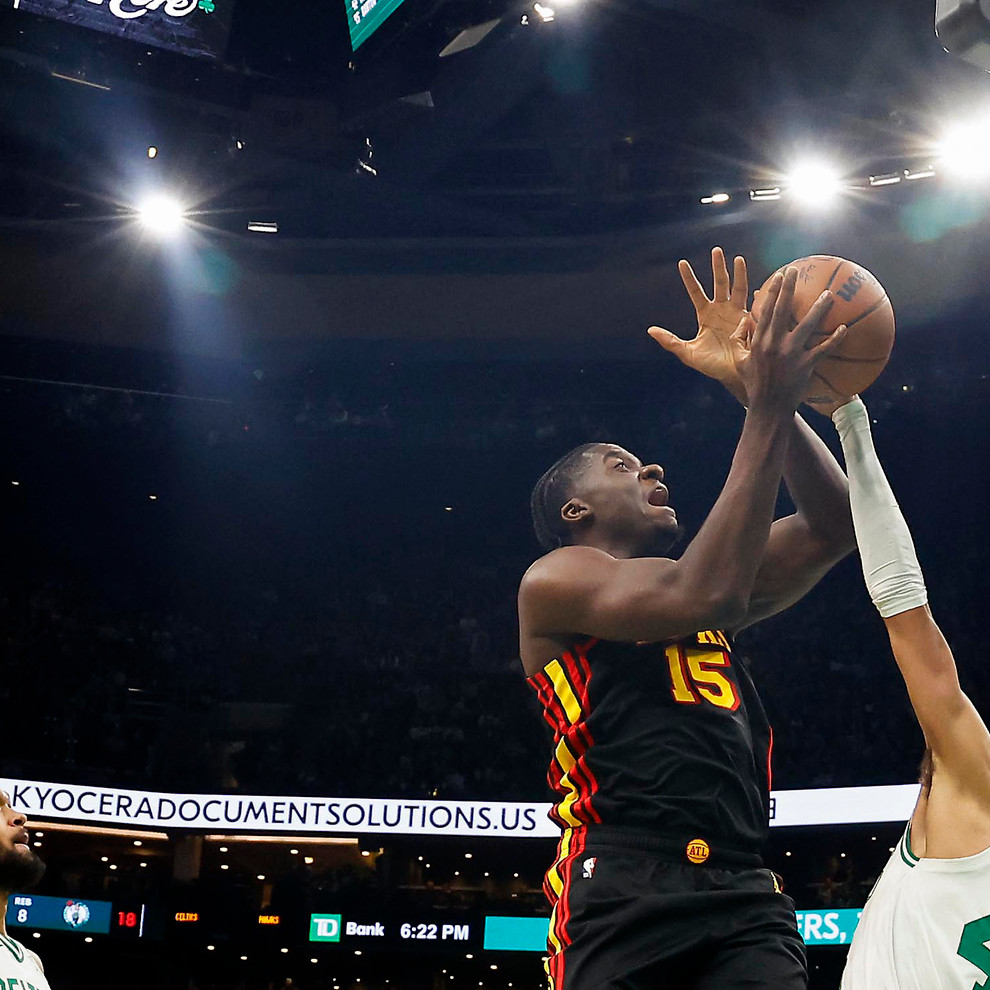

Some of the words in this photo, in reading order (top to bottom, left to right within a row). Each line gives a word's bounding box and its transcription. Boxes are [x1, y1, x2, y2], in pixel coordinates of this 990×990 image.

[665, 645, 740, 711] 15
[12, 784, 537, 832] KYOCERADOCUMENTSOLUTIONS.US
[689, 845, 707, 857] ATL
[14, 896, 33, 906] REB
[17, 908, 28, 923] 8
[117, 911, 137, 927] 18
[313, 918, 339, 937] TD
[346, 922, 385, 937] Bank
[400, 923, 437, 940] 6:22
[442, 924, 469, 940] PM
